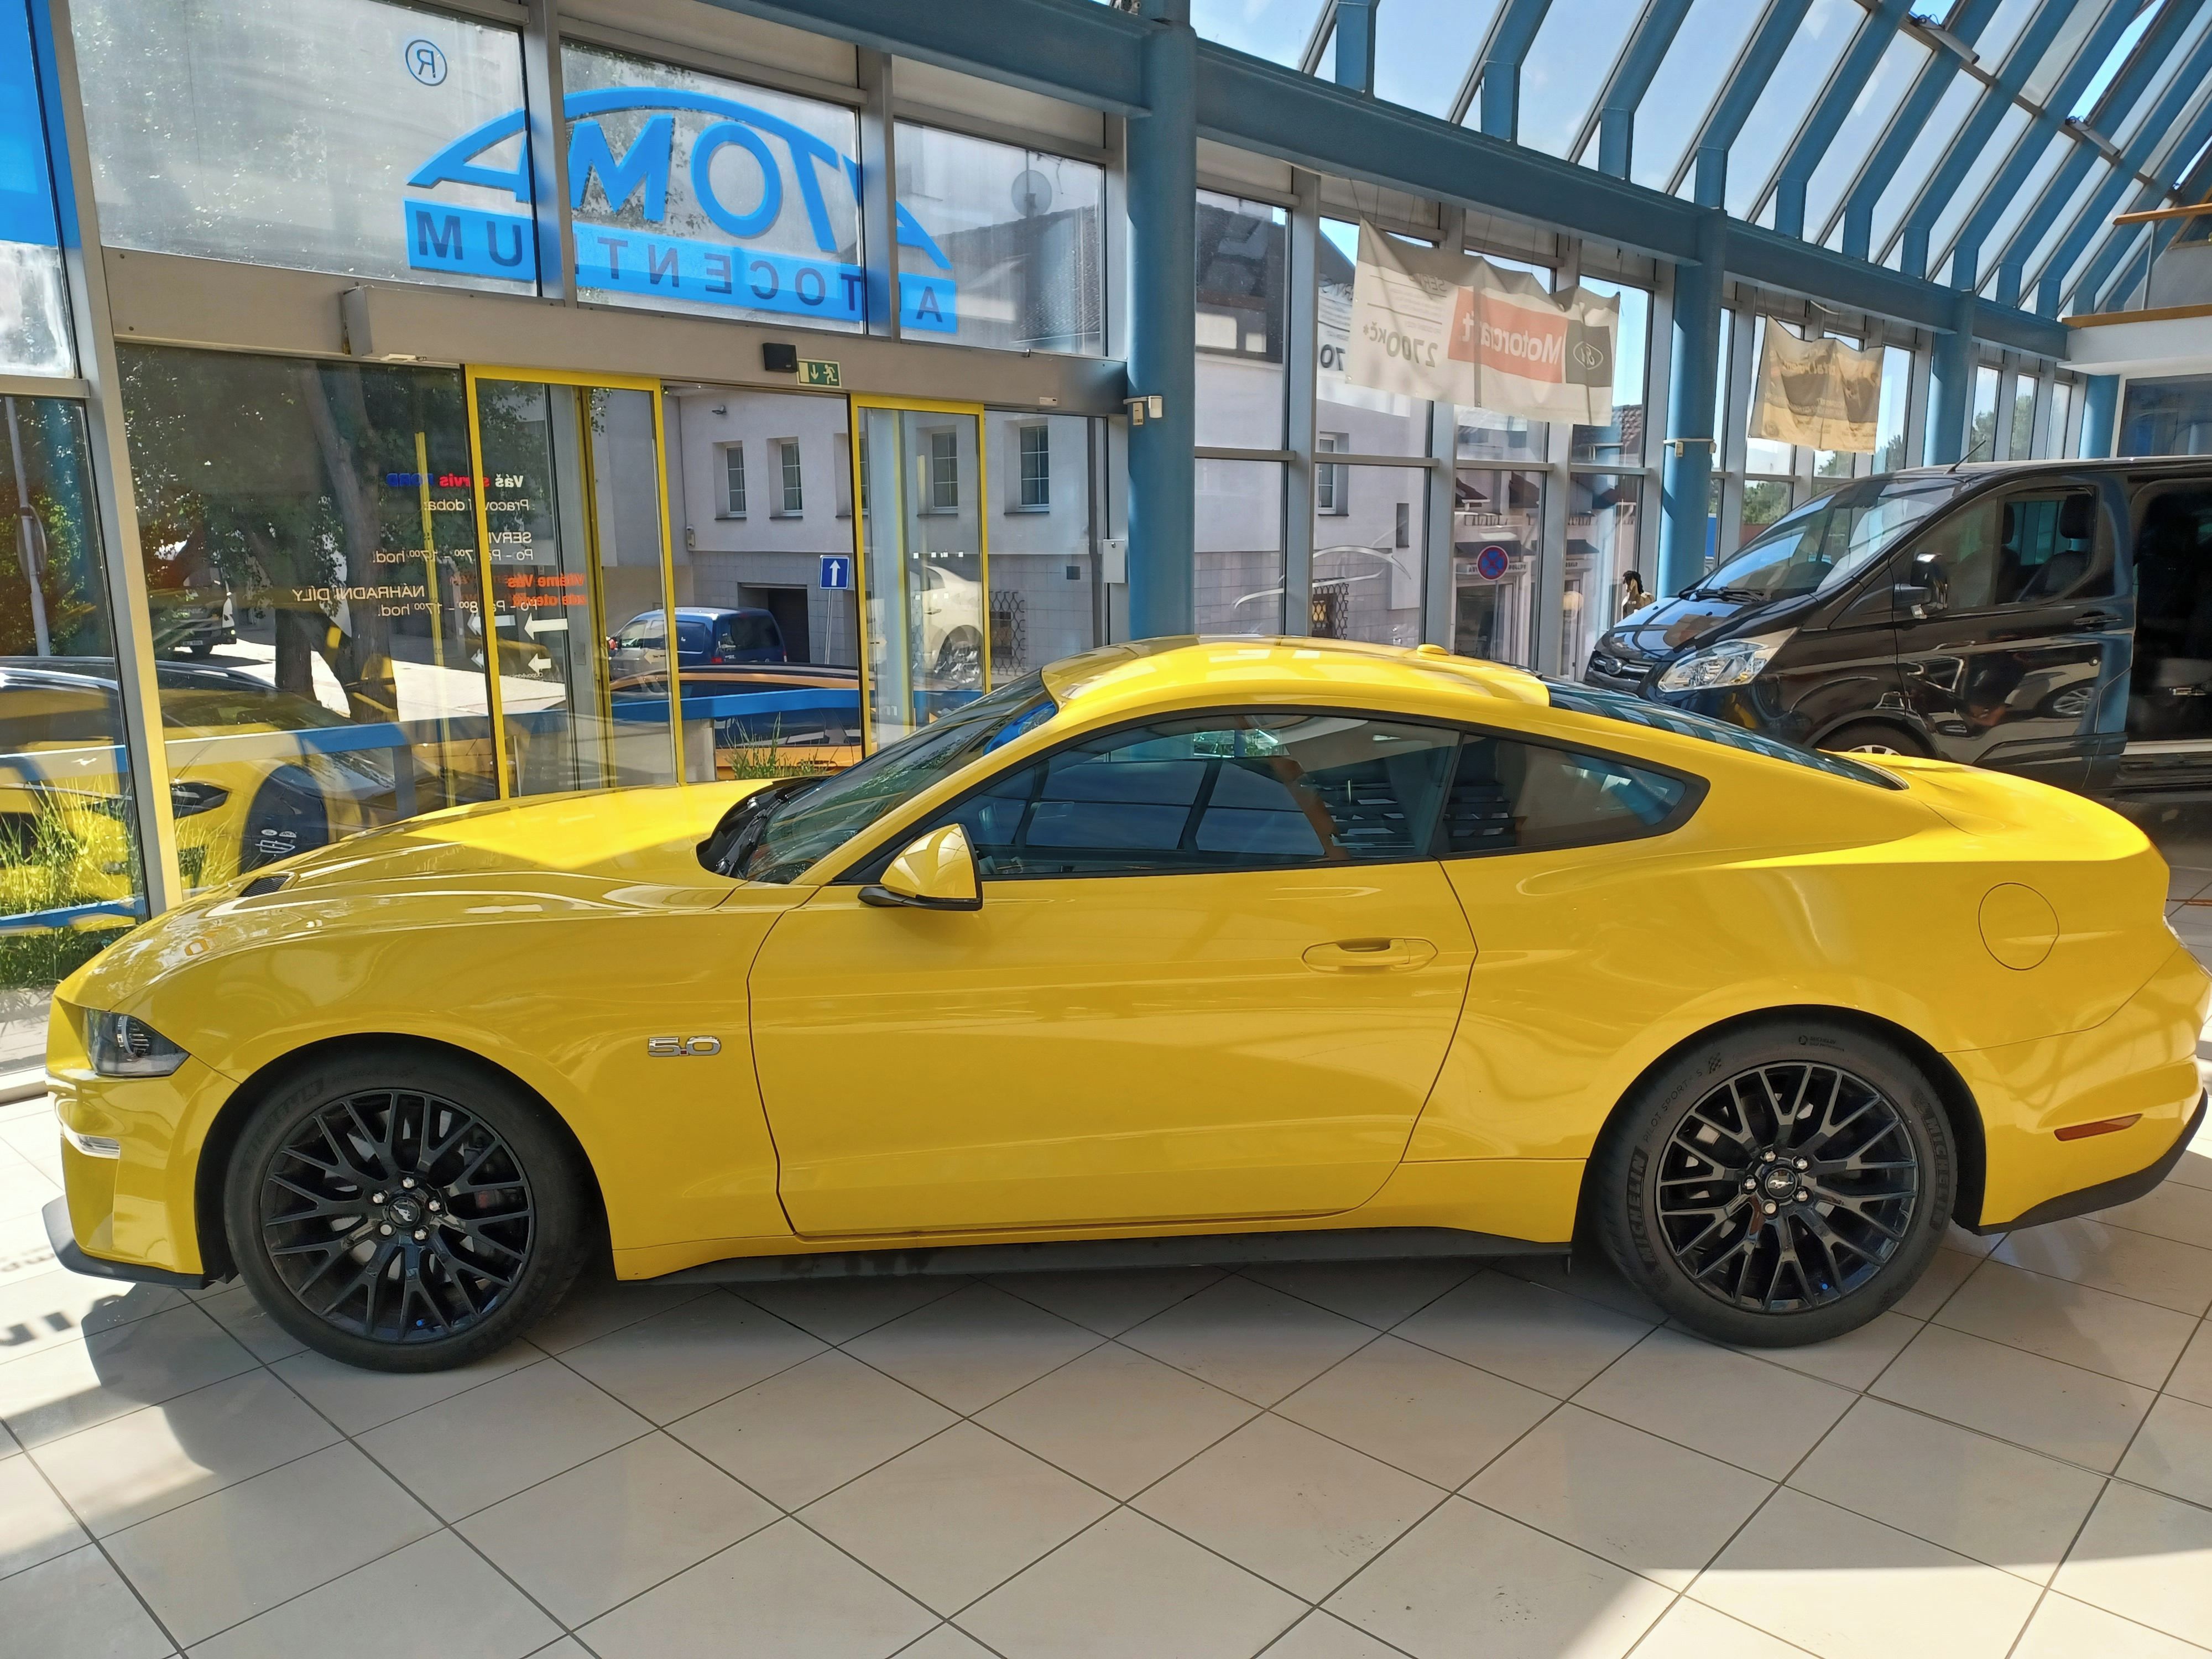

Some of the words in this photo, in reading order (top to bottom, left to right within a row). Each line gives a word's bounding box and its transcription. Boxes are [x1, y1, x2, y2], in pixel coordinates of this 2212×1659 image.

[648, 1035, 722, 1057] 5.0
[1643, 1112, 1662, 1143] PILOT
[1661, 1078, 1688, 1112] SPORT
